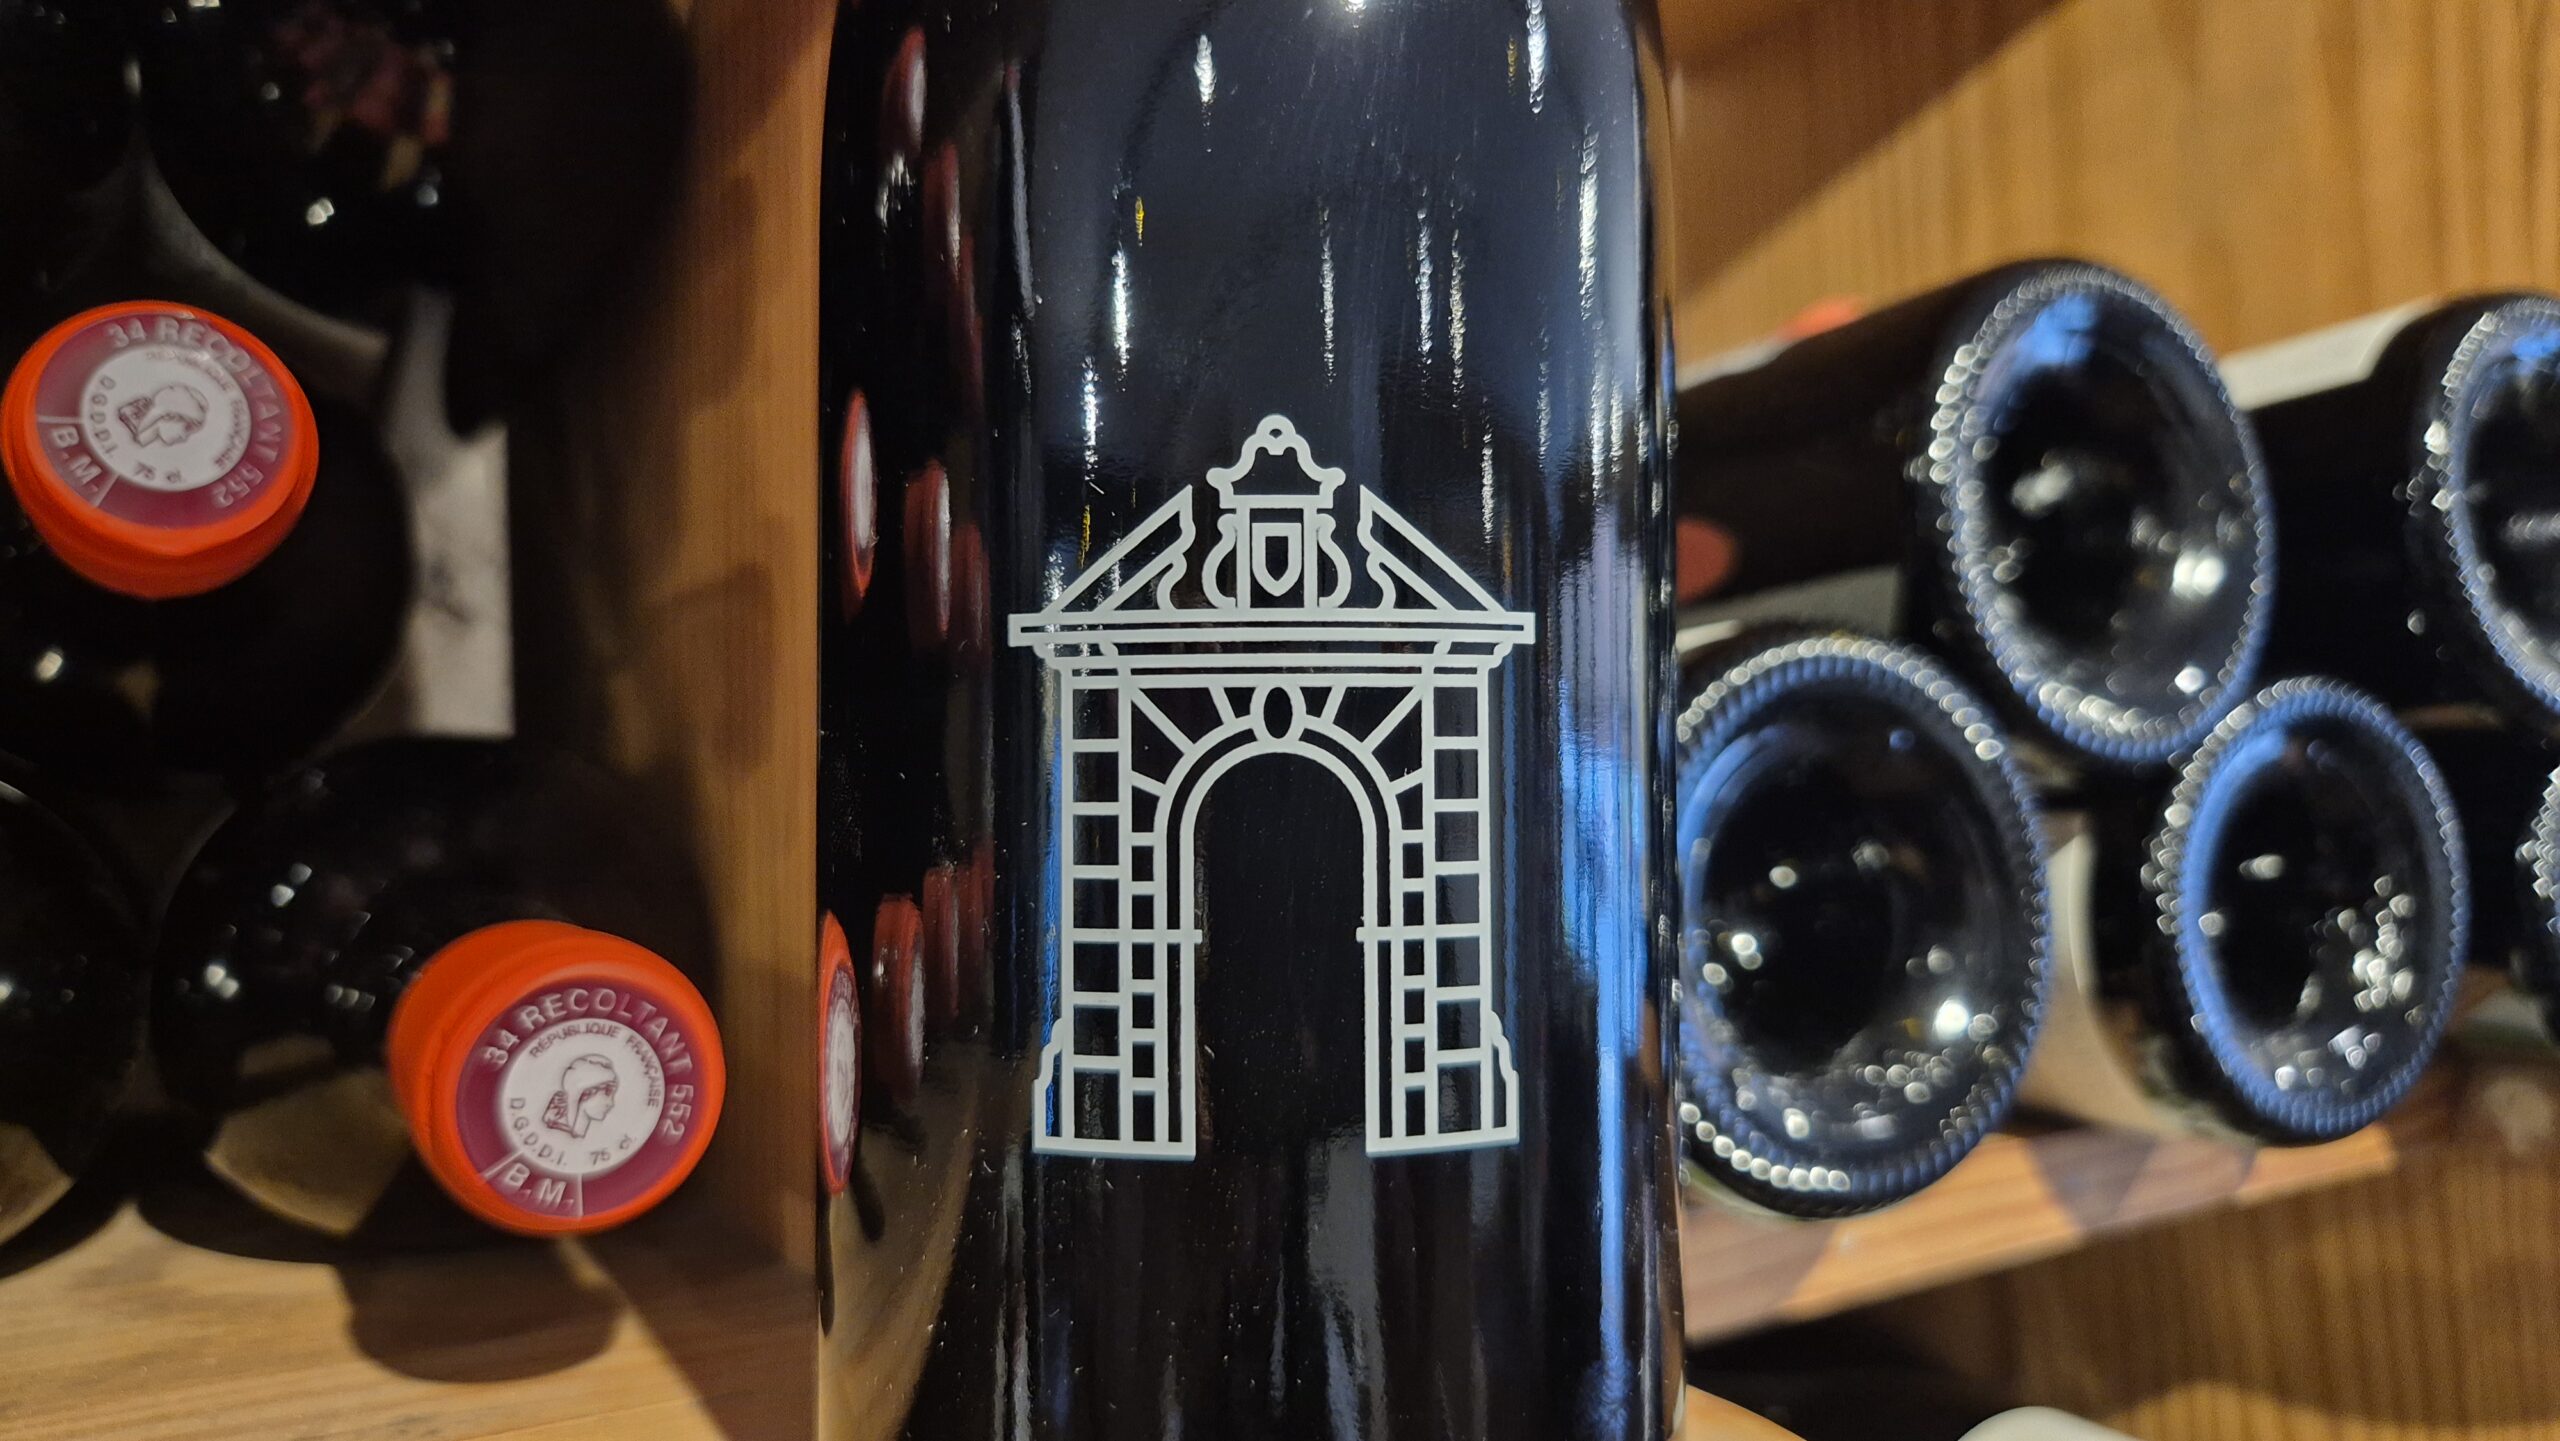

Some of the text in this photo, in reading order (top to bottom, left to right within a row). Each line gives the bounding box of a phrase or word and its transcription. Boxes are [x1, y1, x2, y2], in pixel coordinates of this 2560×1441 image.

[105, 317, 147, 348] 34
[155, 315, 282, 464] RECOLTANT
[211, 461, 265, 509] 552
[482, 987, 695, 1140] 34 RECOLTANT 552
[589, 1147, 612, 1166] 75
[502, 1161, 576, 1208] B.M.
